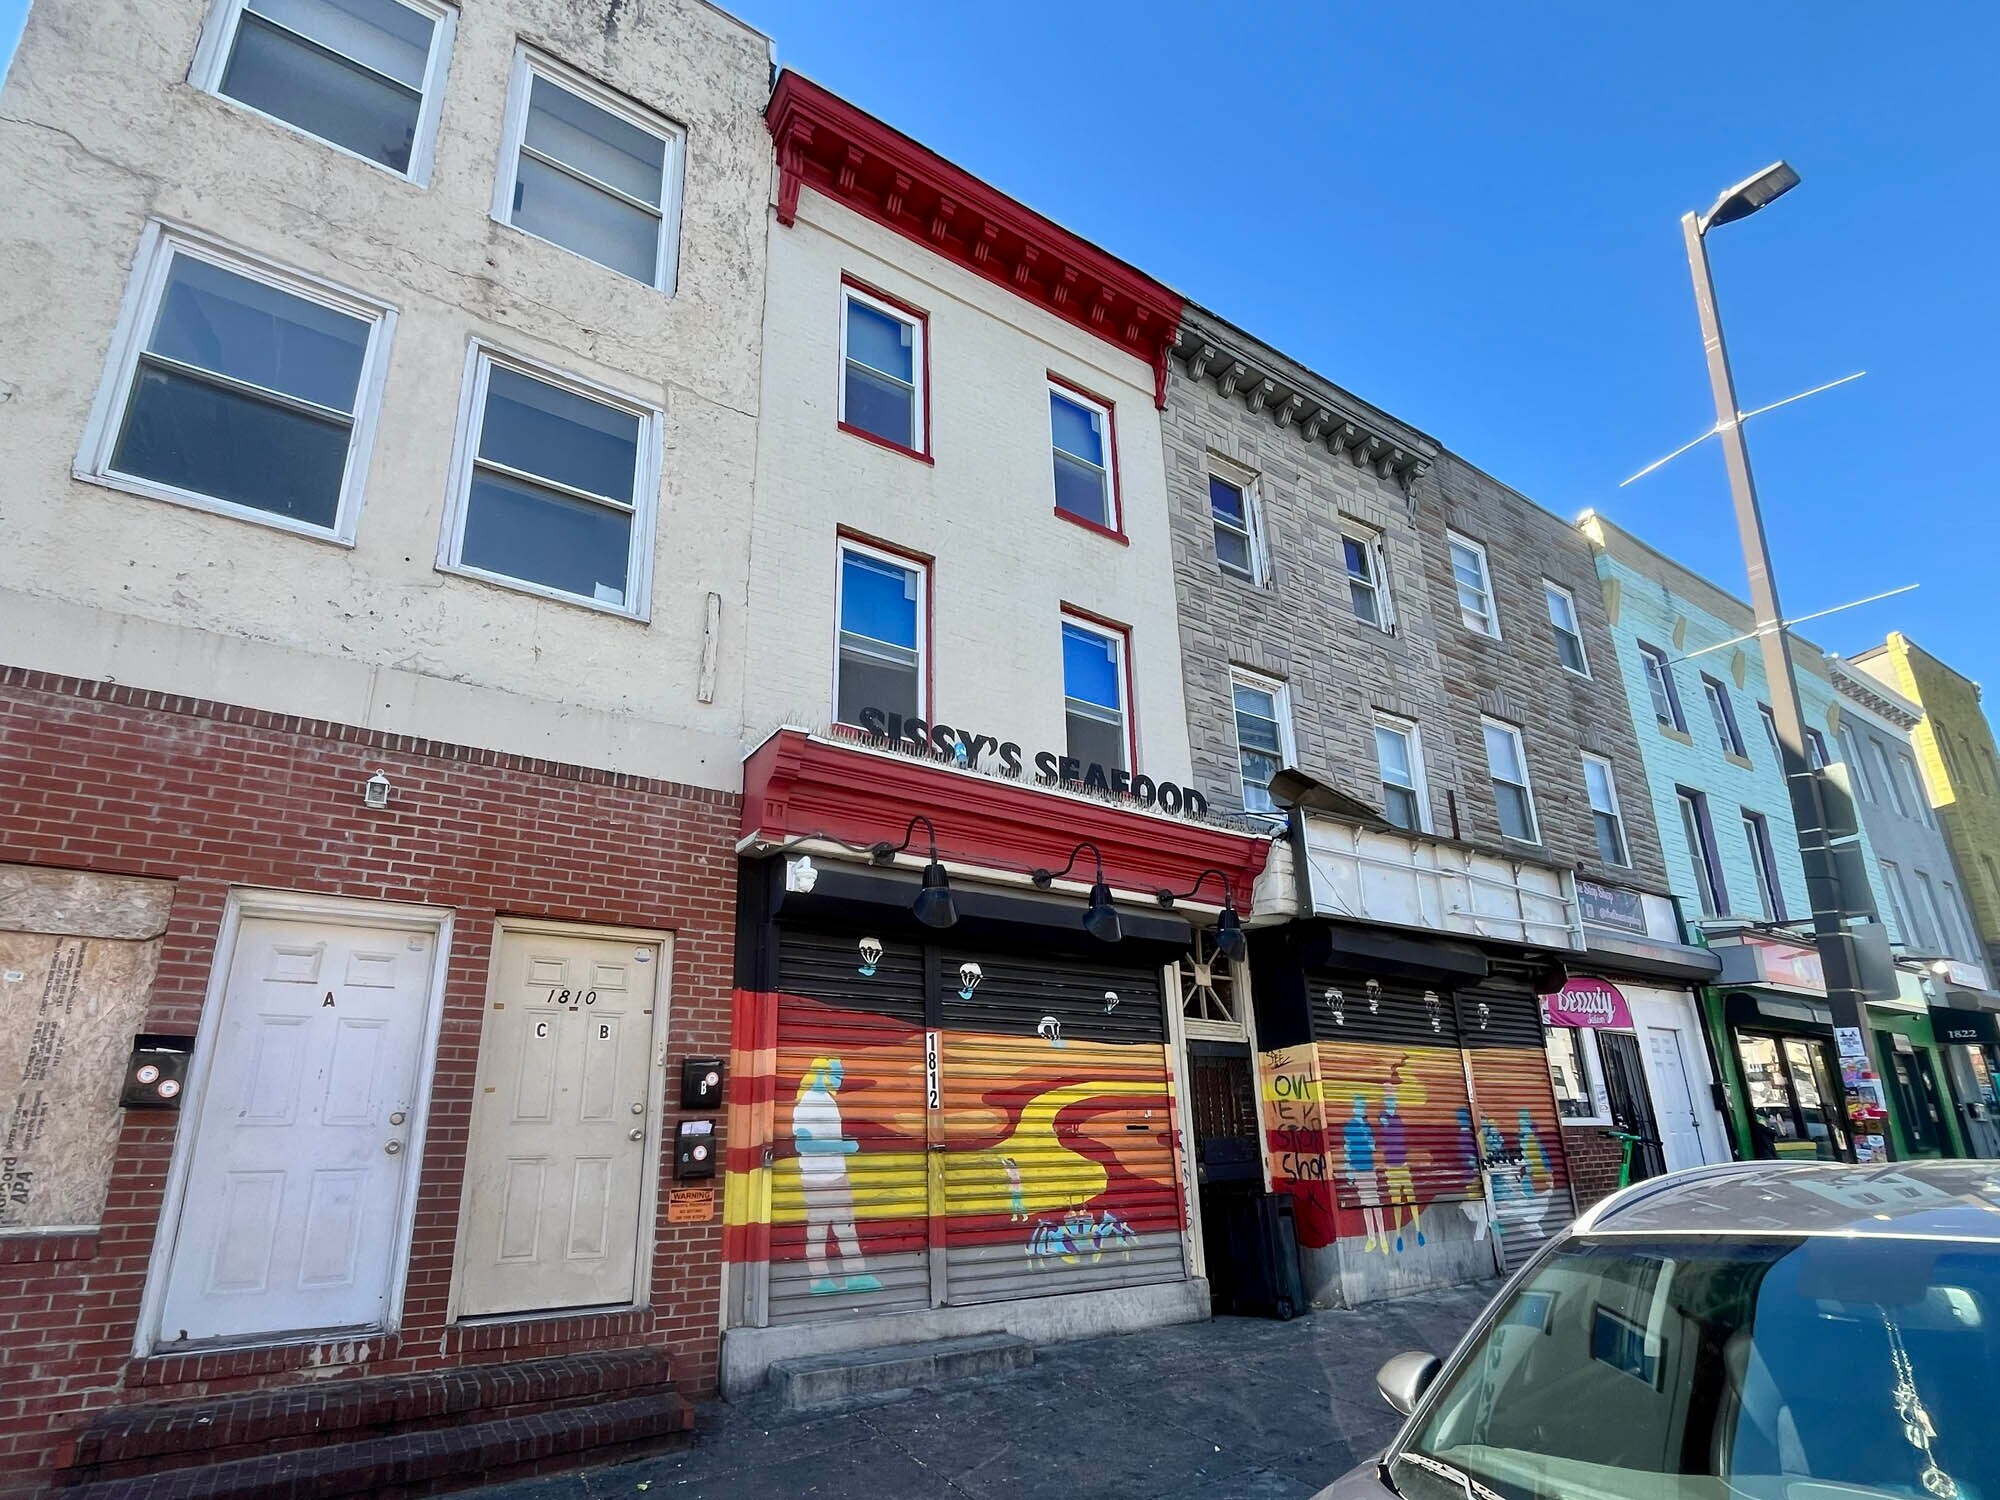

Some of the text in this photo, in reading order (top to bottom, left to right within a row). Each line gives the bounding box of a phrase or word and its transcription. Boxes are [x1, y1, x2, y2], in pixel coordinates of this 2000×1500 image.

[859, 706, 1208, 819] SISSY'S SEAFOOD
[322, 992, 335, 1007] A
[547, 989, 597, 1005] 1810
[536, 1023, 547, 1037] C
[599, 1025, 609, 1039] B
[1947, 1029, 1978, 1039] 1822
[928, 1033, 938, 1109] 1812
[700, 1081, 708, 1096] B
[10, 1171, 33, 1205] APA
[673, 1191, 711, 1200] WARNING
